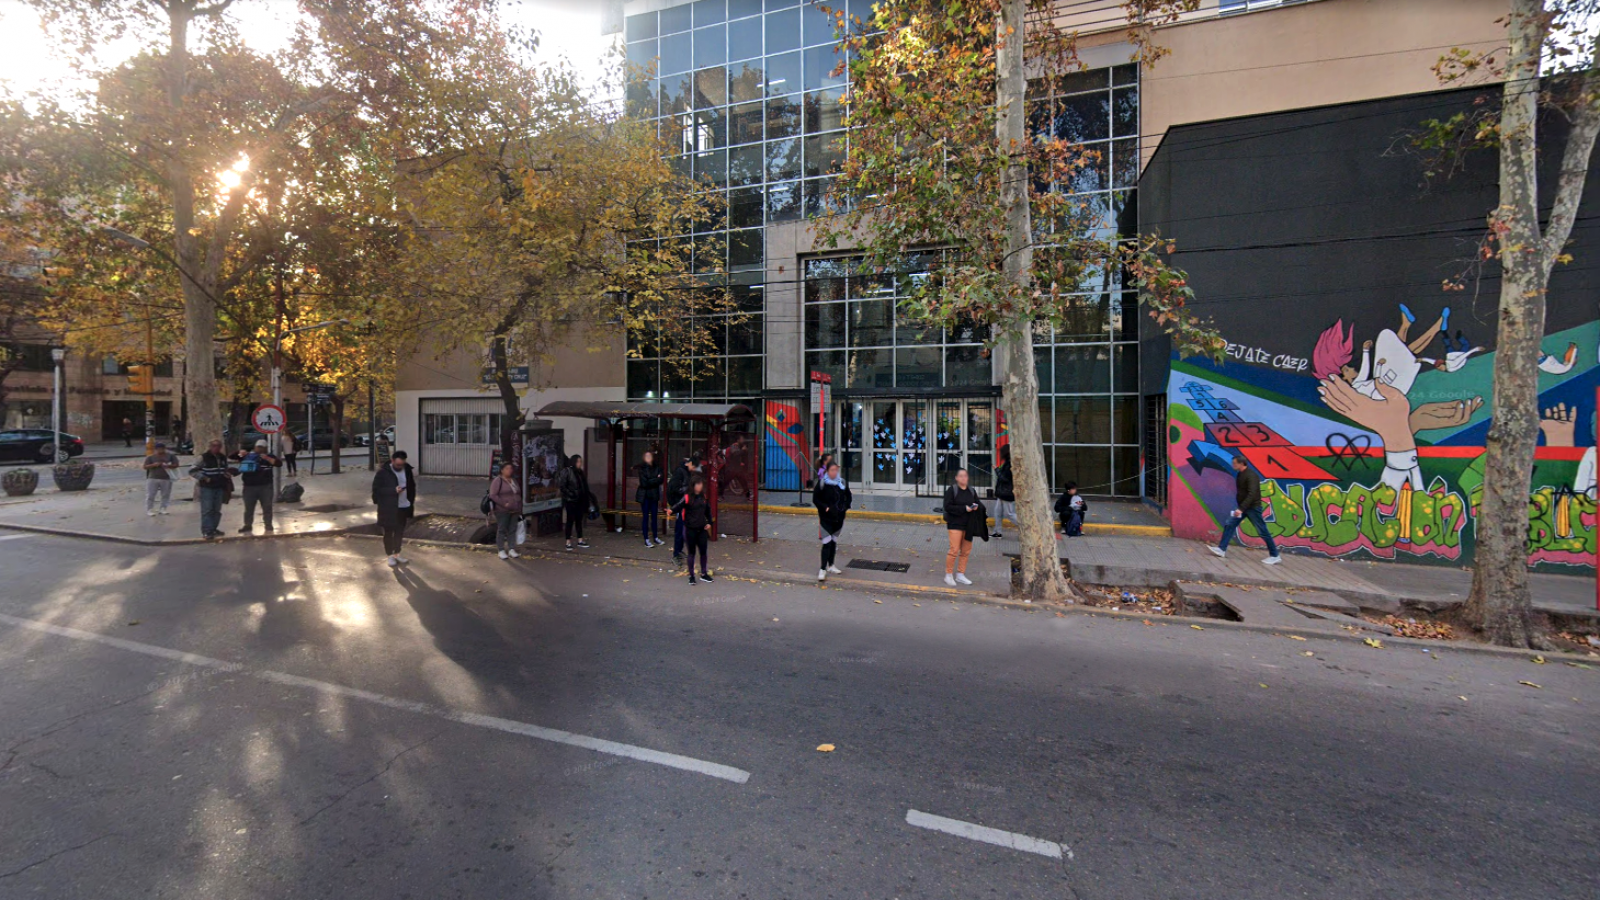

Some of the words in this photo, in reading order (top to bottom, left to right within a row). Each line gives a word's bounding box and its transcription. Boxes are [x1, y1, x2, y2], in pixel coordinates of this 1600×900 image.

[1272, 354, 1308, 372] CAER
[1218, 400, 1228, 409] 6
[1217, 426, 1240, 443] 2
[1246, 424, 1271, 442] 3
[1266, 454, 1290, 472] 1
